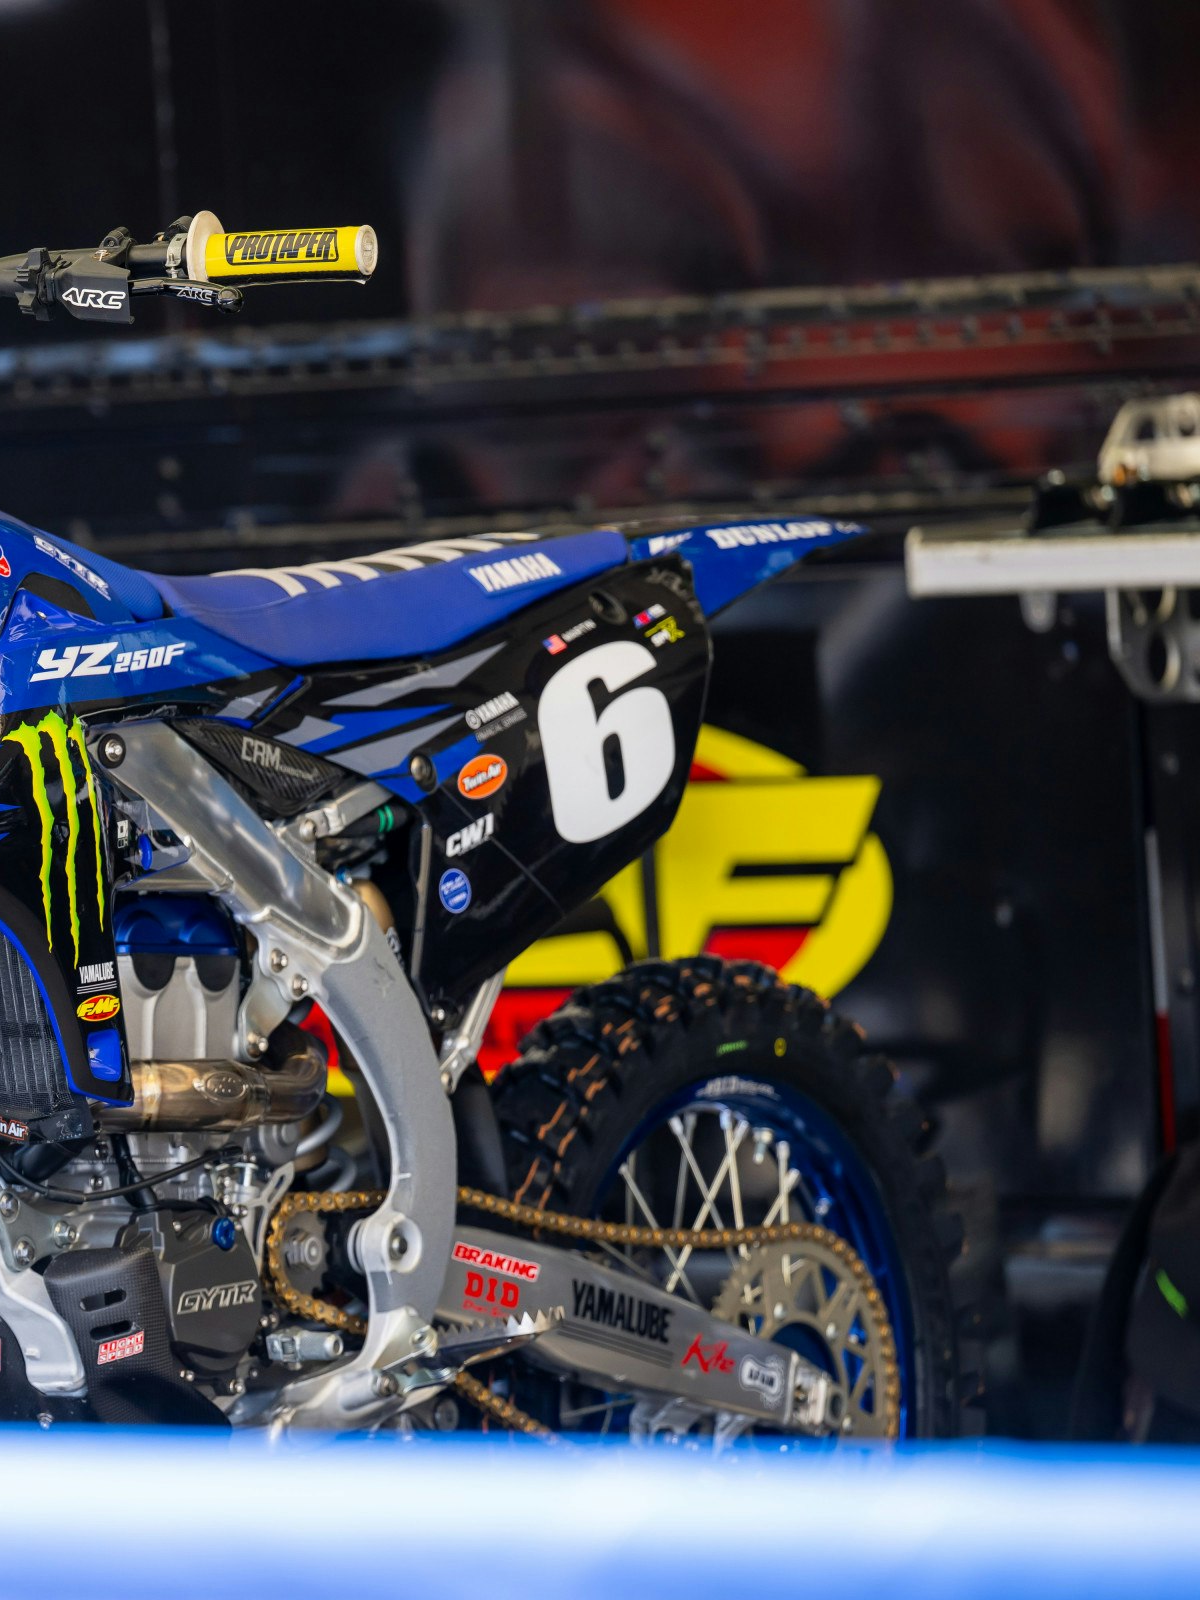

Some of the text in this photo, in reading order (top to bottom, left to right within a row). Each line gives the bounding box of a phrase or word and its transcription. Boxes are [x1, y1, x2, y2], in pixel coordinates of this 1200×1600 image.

[230, 232, 337, 262] PROTAPER
[62, 287, 126, 310] ARC
[176, 286, 213, 302] ARC
[705, 521, 834, 550] DUNLOP
[469, 553, 563, 593] YAMAHA
[30, 641, 186, 683] YZ 250F
[241, 736, 281, 772] CRM
[537, 640, 676, 844] 6
[78, 961, 115, 985] YAMALUBE
[78, 998, 119, 1019] FMF
[7, 1120, 27, 1139] Air
[455, 1245, 538, 1280] BRAKING
[176, 1280, 257, 1315] GYTR
[572, 1279, 675, 1344] YAMALUBE
[99, 1332, 144, 1354] LIGHT
[99, 1343, 144, 1364] SPEED
